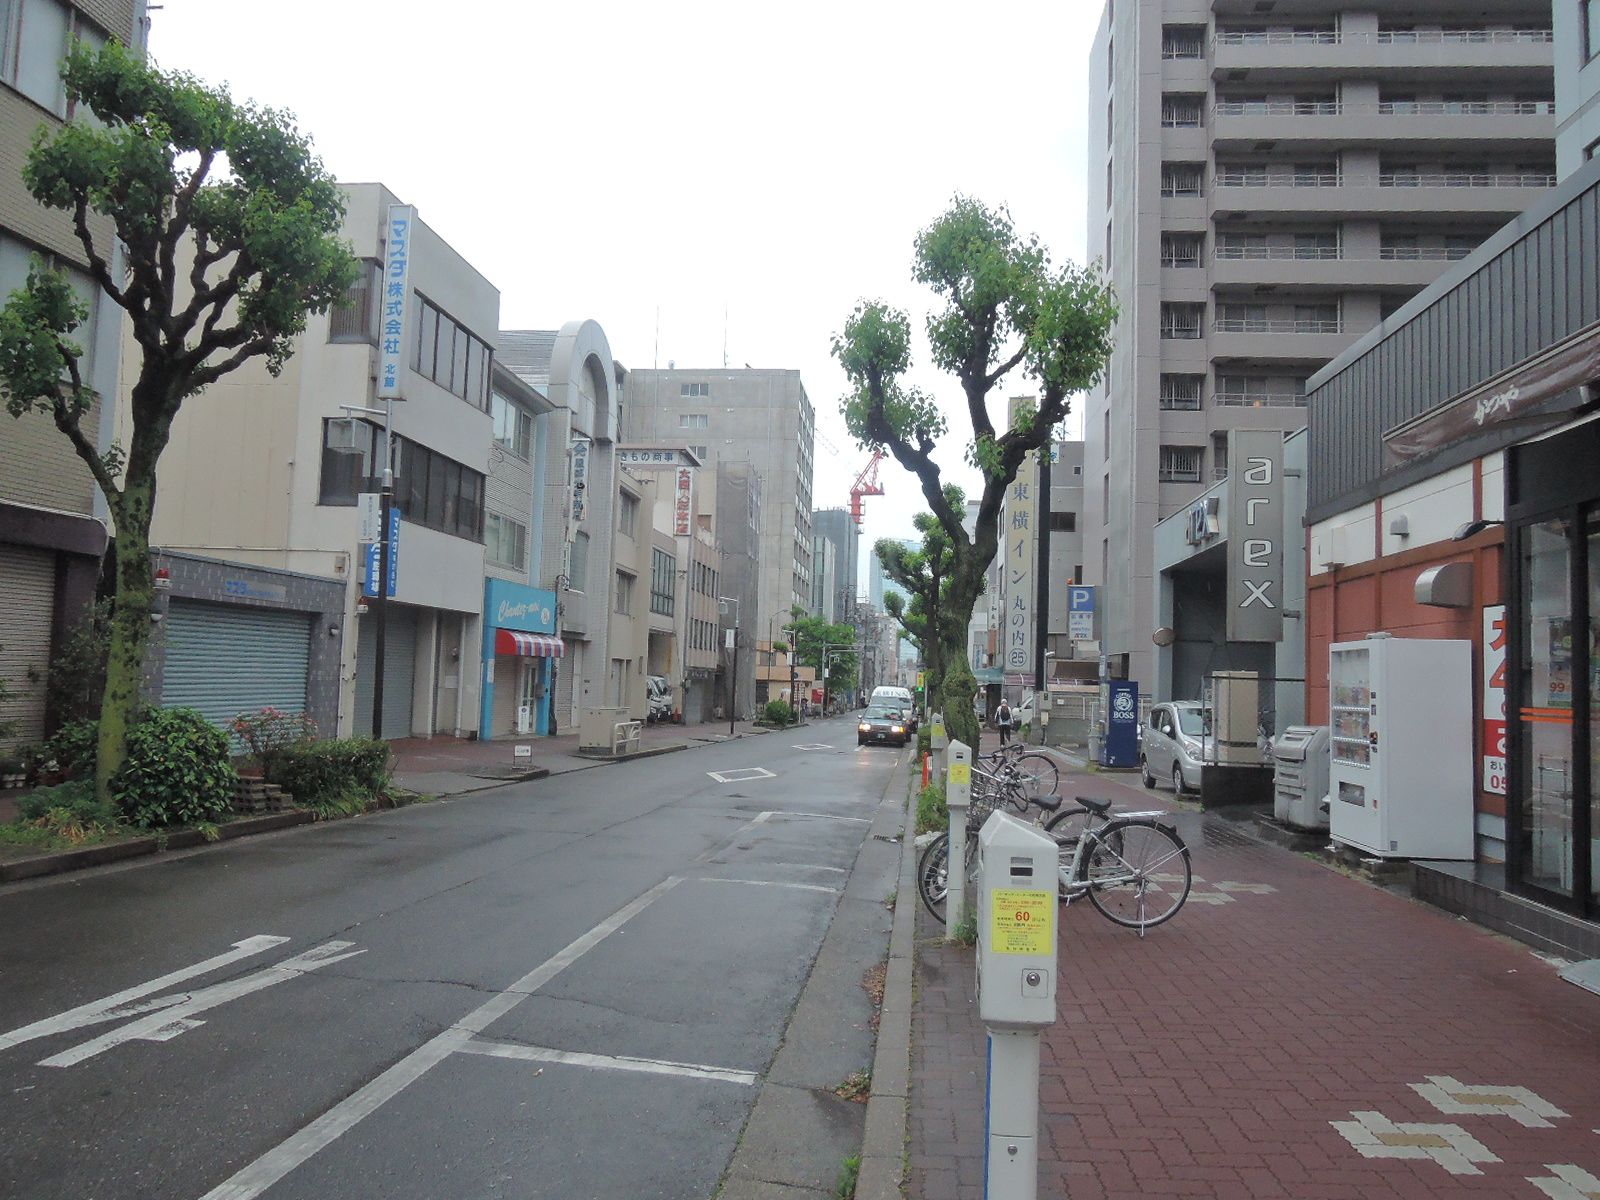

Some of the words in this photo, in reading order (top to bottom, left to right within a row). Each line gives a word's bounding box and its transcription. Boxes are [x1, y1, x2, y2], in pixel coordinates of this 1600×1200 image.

[384, 219, 407, 354] マスダ株式会社
[1239, 457, 1277, 609] arex
[1073, 590, 1089, 609] P
[1113, 711, 1135, 719] BOSS
[1015, 911, 1030, 921] 60
